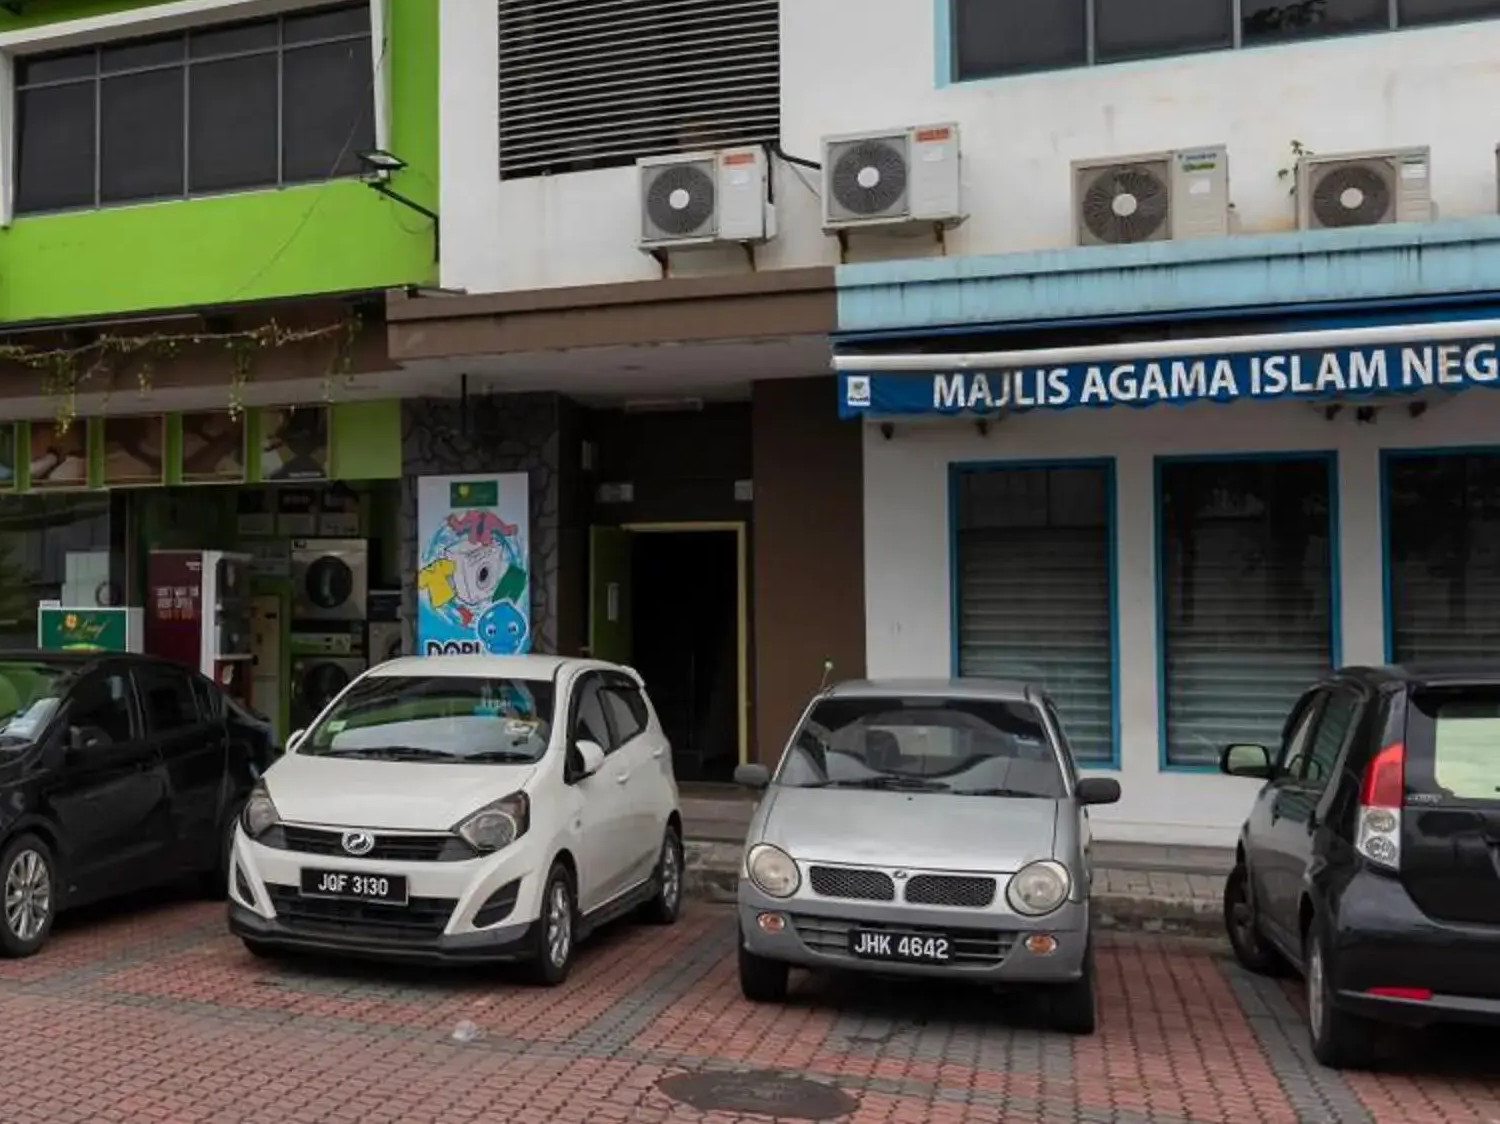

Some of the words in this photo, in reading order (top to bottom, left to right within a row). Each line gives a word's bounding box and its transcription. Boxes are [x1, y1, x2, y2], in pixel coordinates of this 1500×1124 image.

[932, 367, 1073, 408] MAJLIS
[1080, 358, 1240, 404] AGAMA
[1250, 348, 1389, 394] ISLAM
[1401, 341, 1500, 387] NEG
[352, 875, 389, 896] 3130
[854, 933, 891, 955] JHK
[898, 936, 949, 959] 4642
